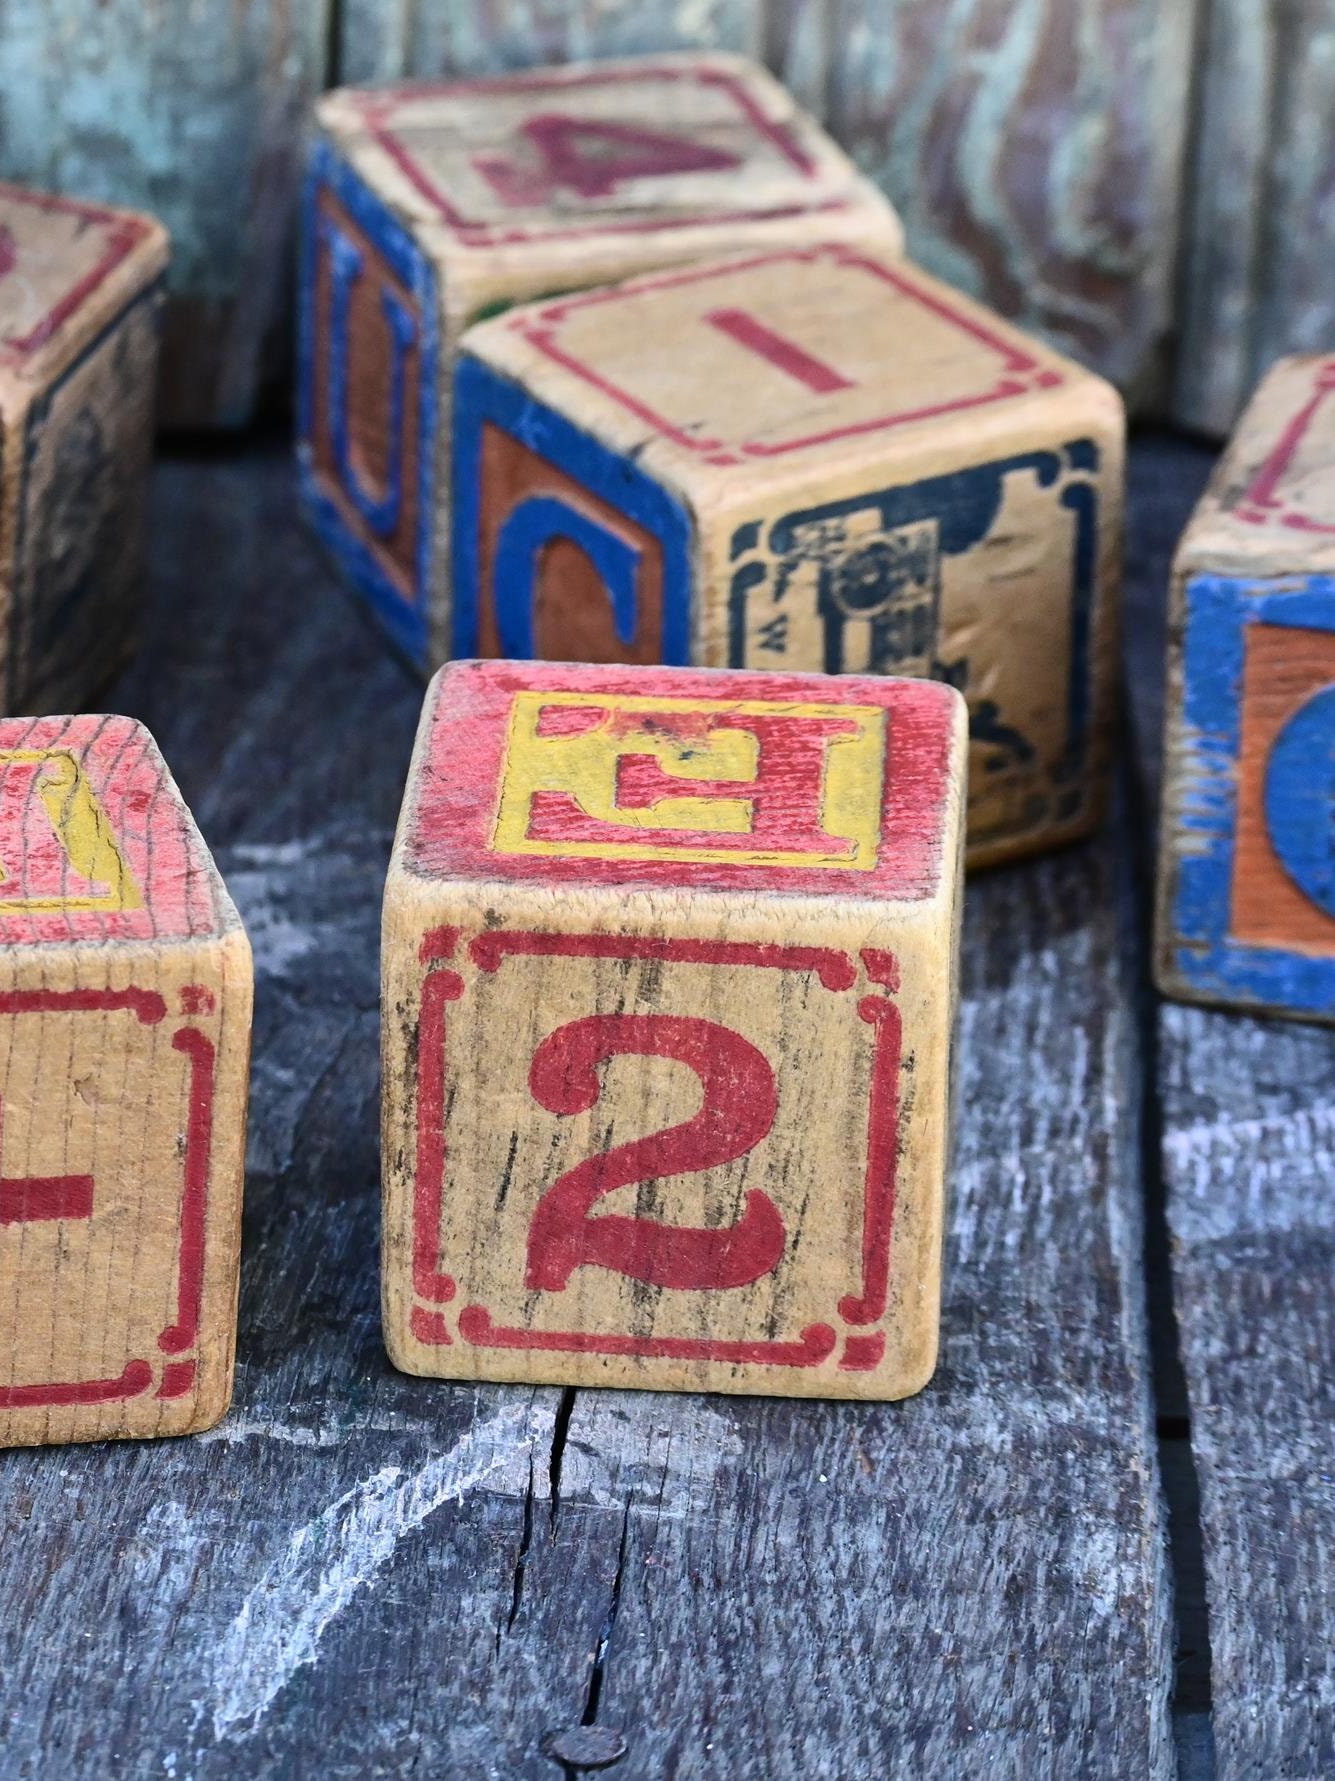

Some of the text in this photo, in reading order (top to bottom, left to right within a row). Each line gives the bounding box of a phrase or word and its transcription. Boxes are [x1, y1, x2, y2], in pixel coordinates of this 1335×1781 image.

[470, 112, 746, 204] 4
[324, 221, 417, 537] U
[525, 704, 864, 854] E
[525, 1013, 787, 1292] 2
